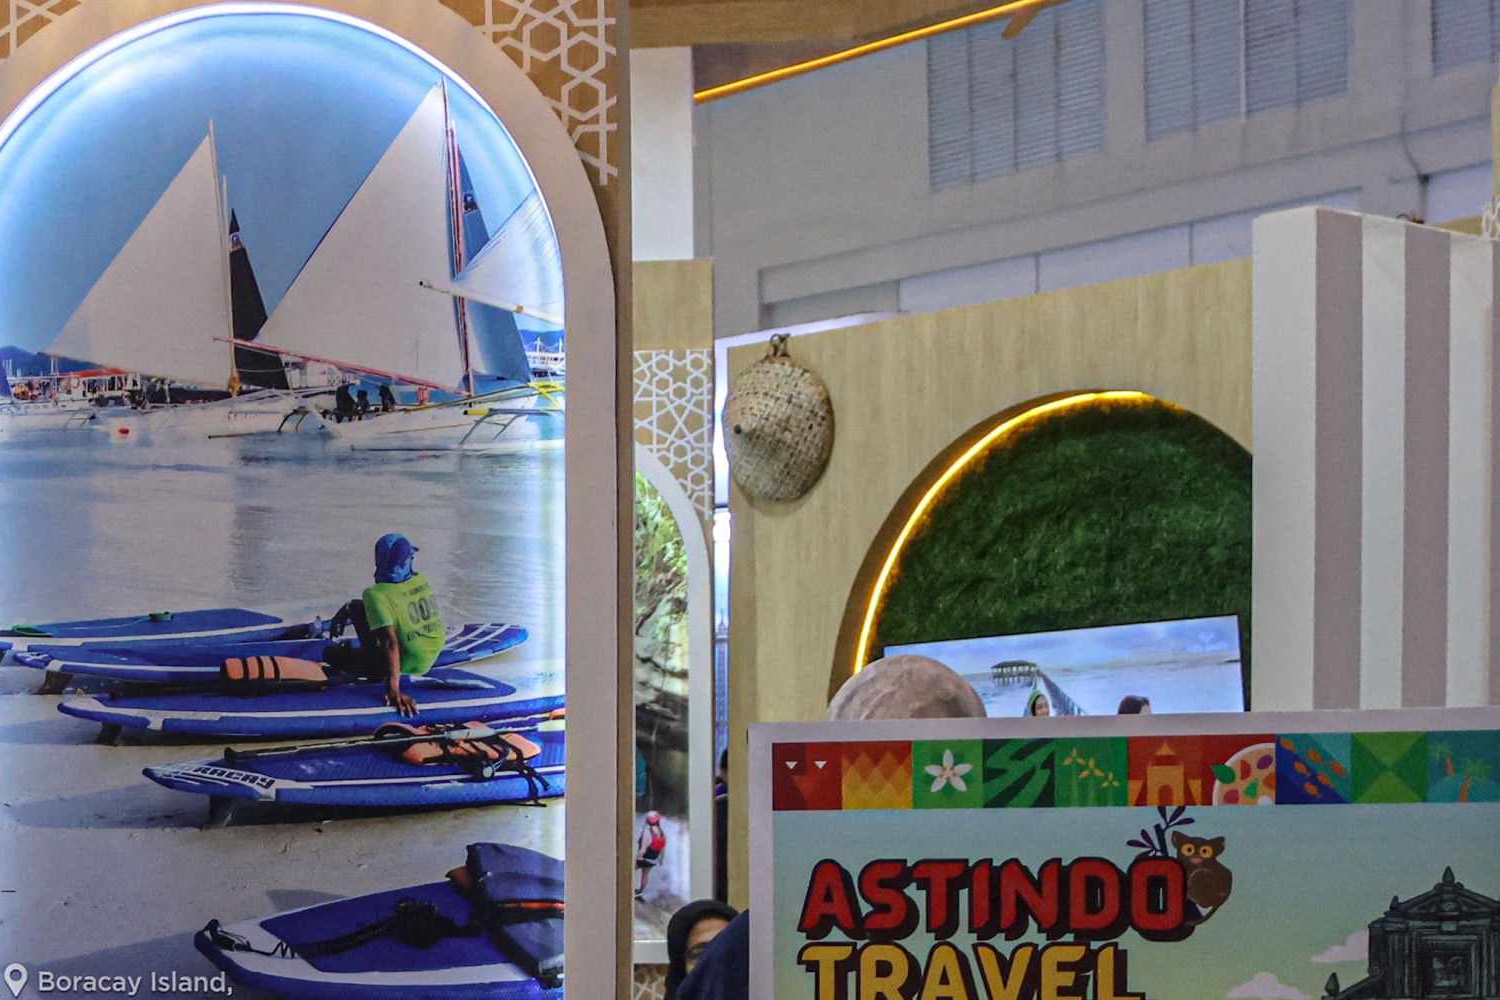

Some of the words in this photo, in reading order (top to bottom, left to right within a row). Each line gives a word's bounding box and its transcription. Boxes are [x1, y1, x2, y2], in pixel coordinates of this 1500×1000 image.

[798, 857, 1197, 940] ASTINDO
[38, 971, 142, 996] Boracay
[151, 971, 233, 996] Island,
